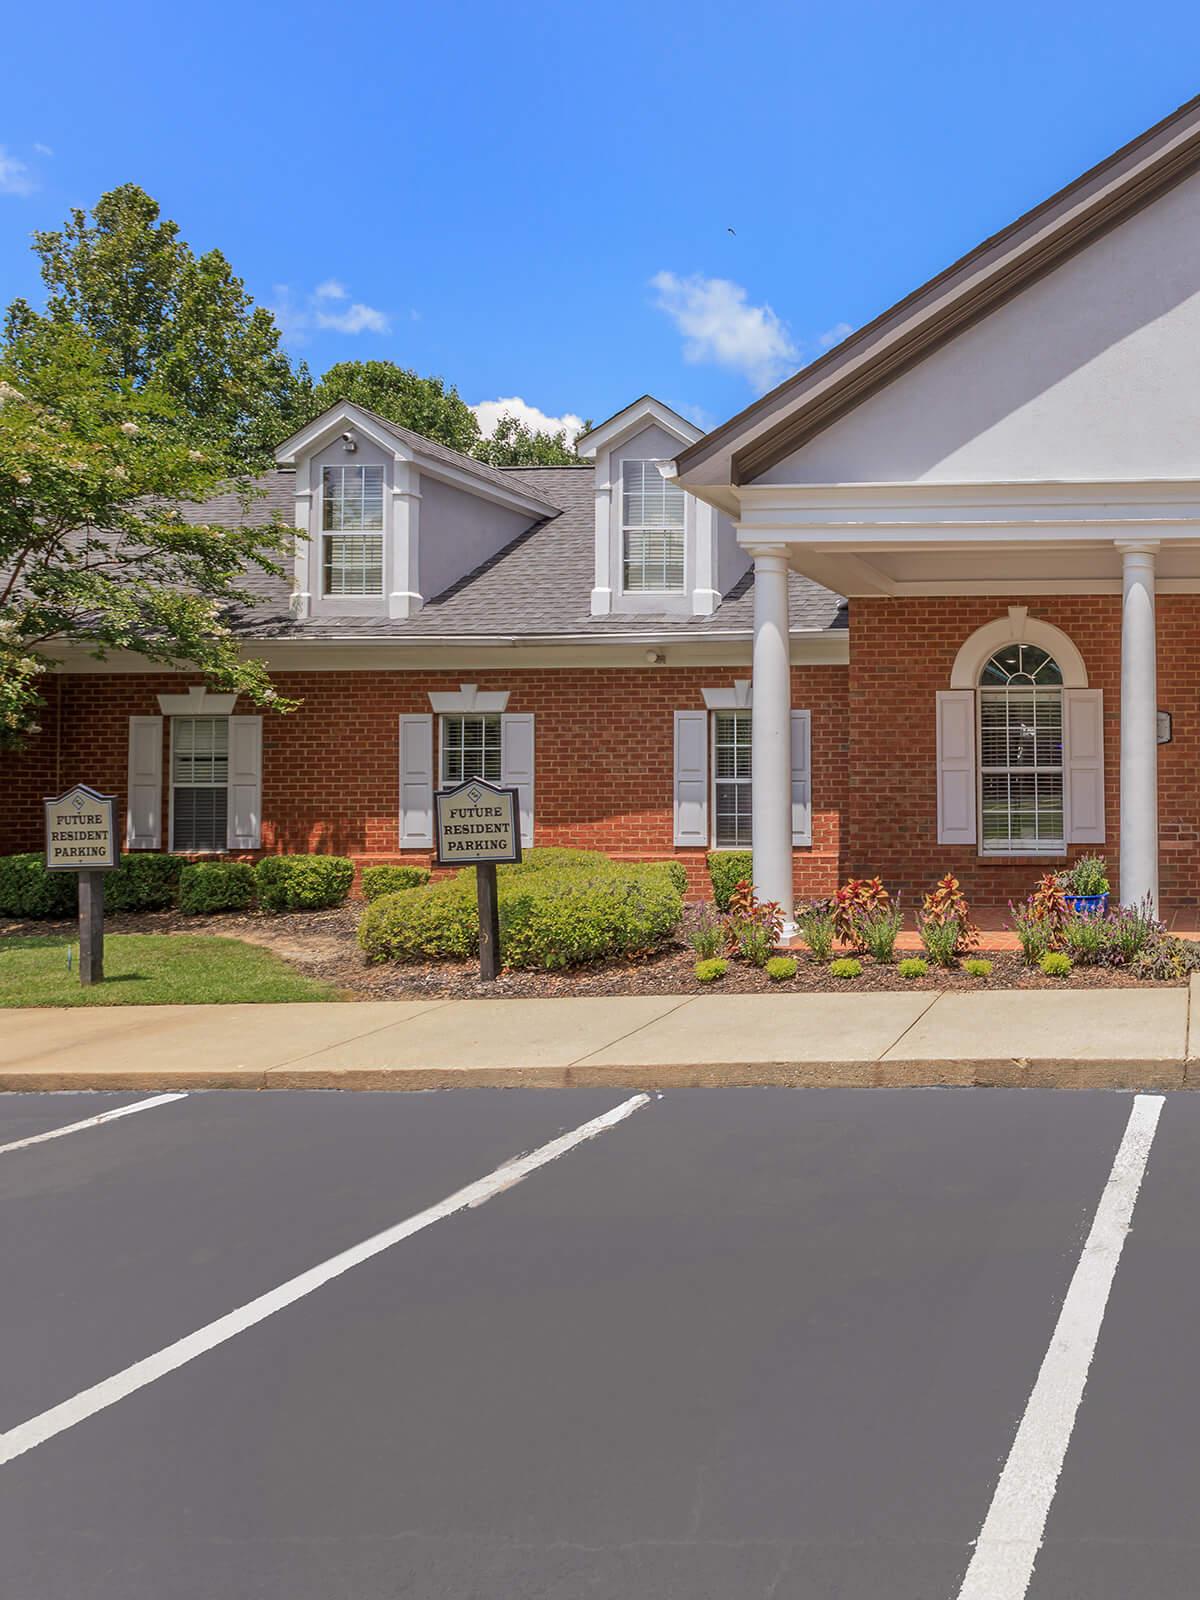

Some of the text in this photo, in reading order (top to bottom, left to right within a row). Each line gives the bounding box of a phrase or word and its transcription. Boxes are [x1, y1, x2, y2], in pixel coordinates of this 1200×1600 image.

[449, 807, 503, 818] FUTURE
[56, 815, 102, 825] FUTURE
[444, 823, 510, 835] RESIDENT
[51, 831, 108, 841] RESIDENT
[448, 839, 507, 851] PARKING
[54, 846, 106, 857] PARKING
